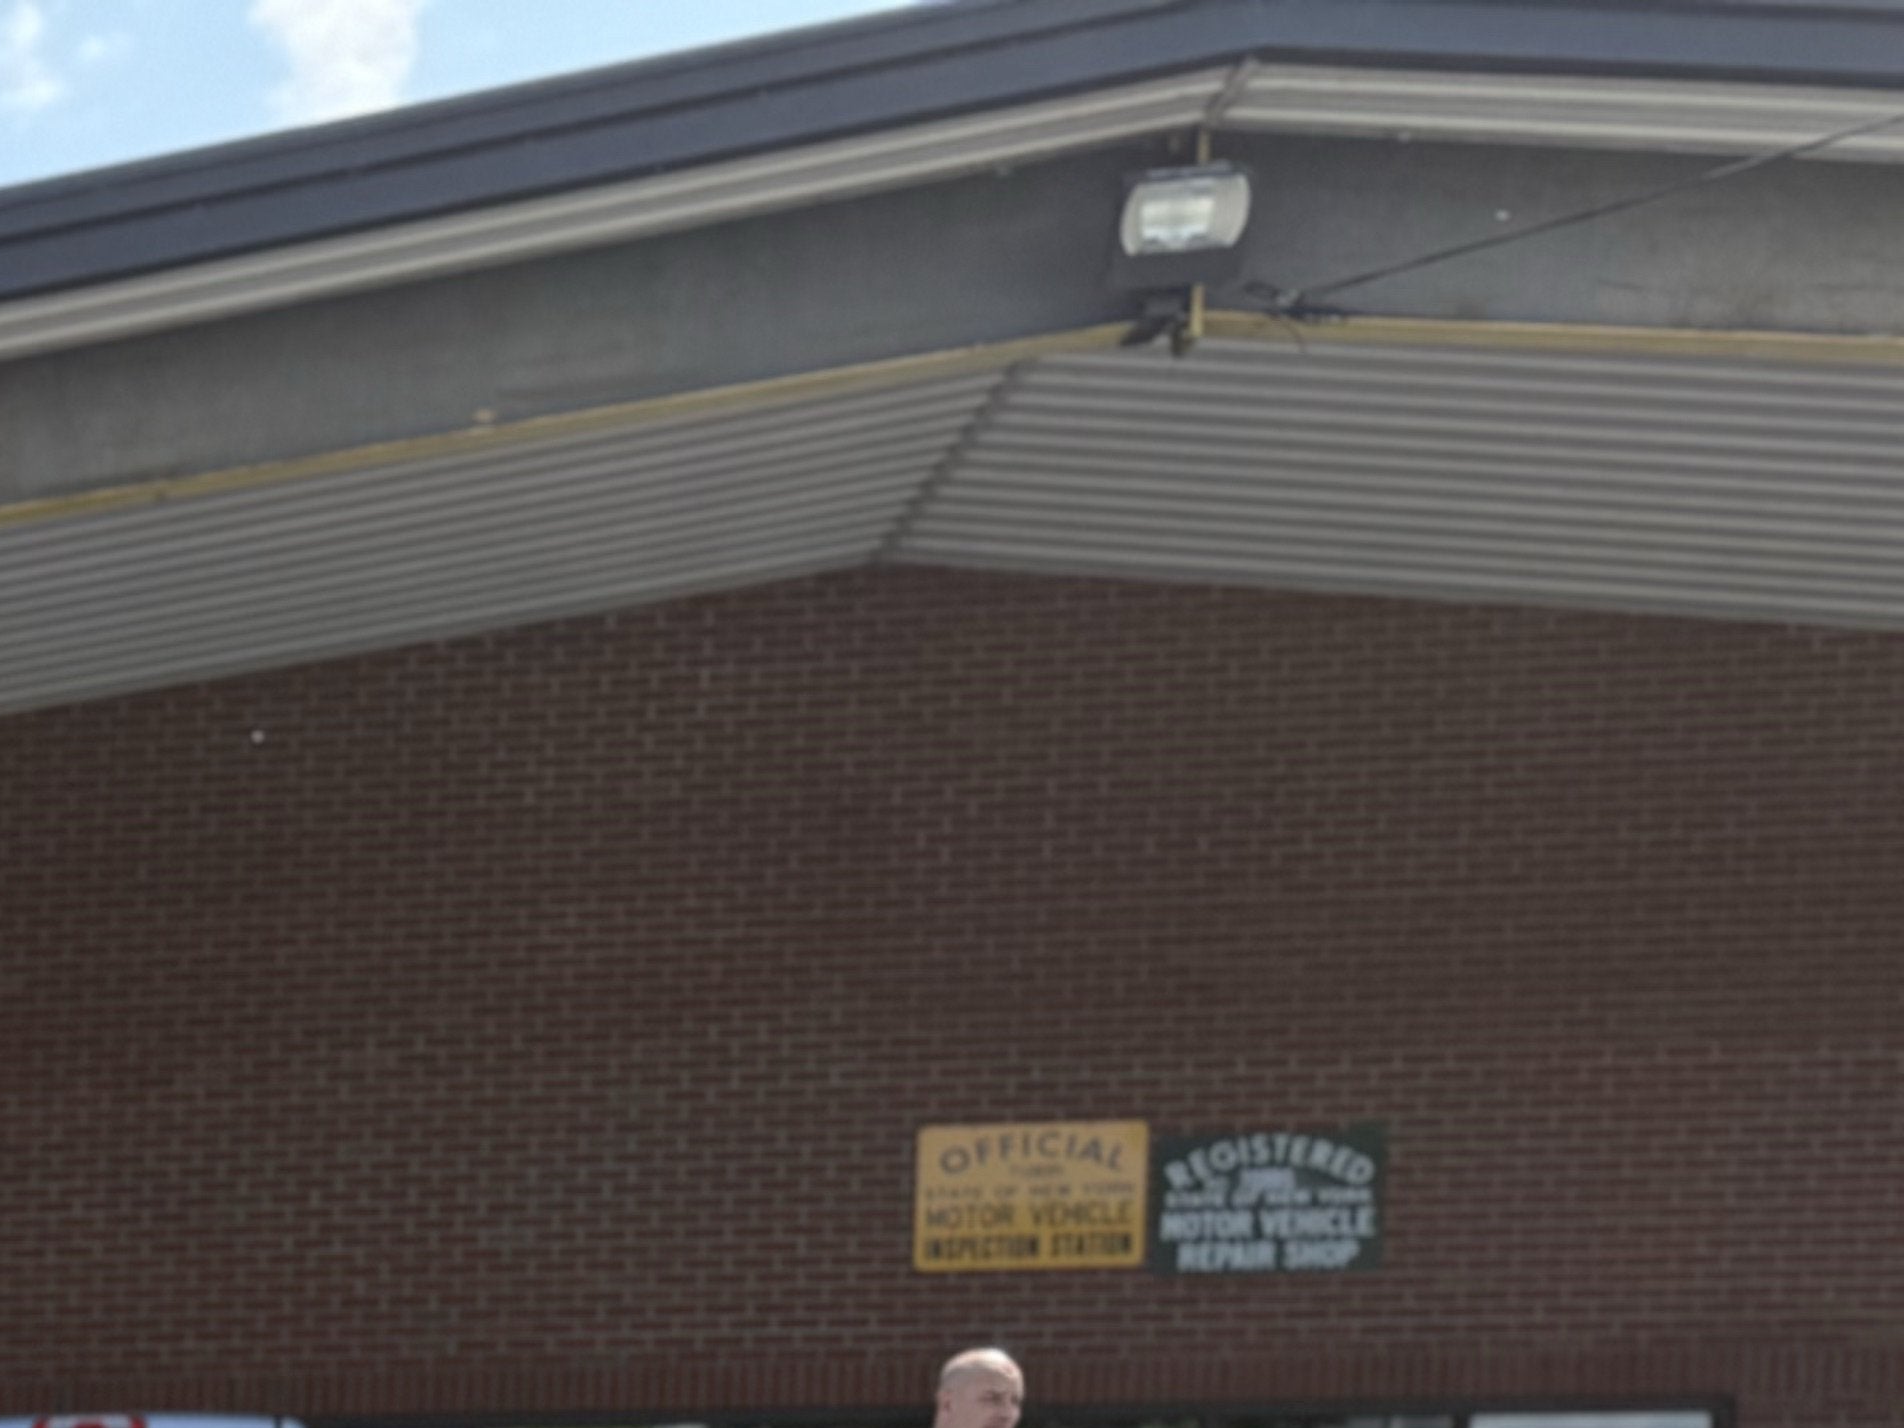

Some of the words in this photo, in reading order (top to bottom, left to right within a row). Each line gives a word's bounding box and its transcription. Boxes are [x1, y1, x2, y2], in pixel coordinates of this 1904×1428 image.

[939, 1130, 1123, 1174] OFFICIAL
[1163, 1131, 1375, 1188] REGISTERED
[926, 1203, 1015, 1227] MOTOR
[1028, 1200, 1132, 1225] VEHICLE
[1159, 1211, 1254, 1241] MOTOR
[1260, 1207, 1377, 1238] VEHICLE
[924, 1233, 1039, 1260] INSPECTION
[1050, 1231, 1132, 1257] STATION
[1176, 1241, 1276, 1273] REPAIR
[1282, 1239, 1361, 1270] SHOP
